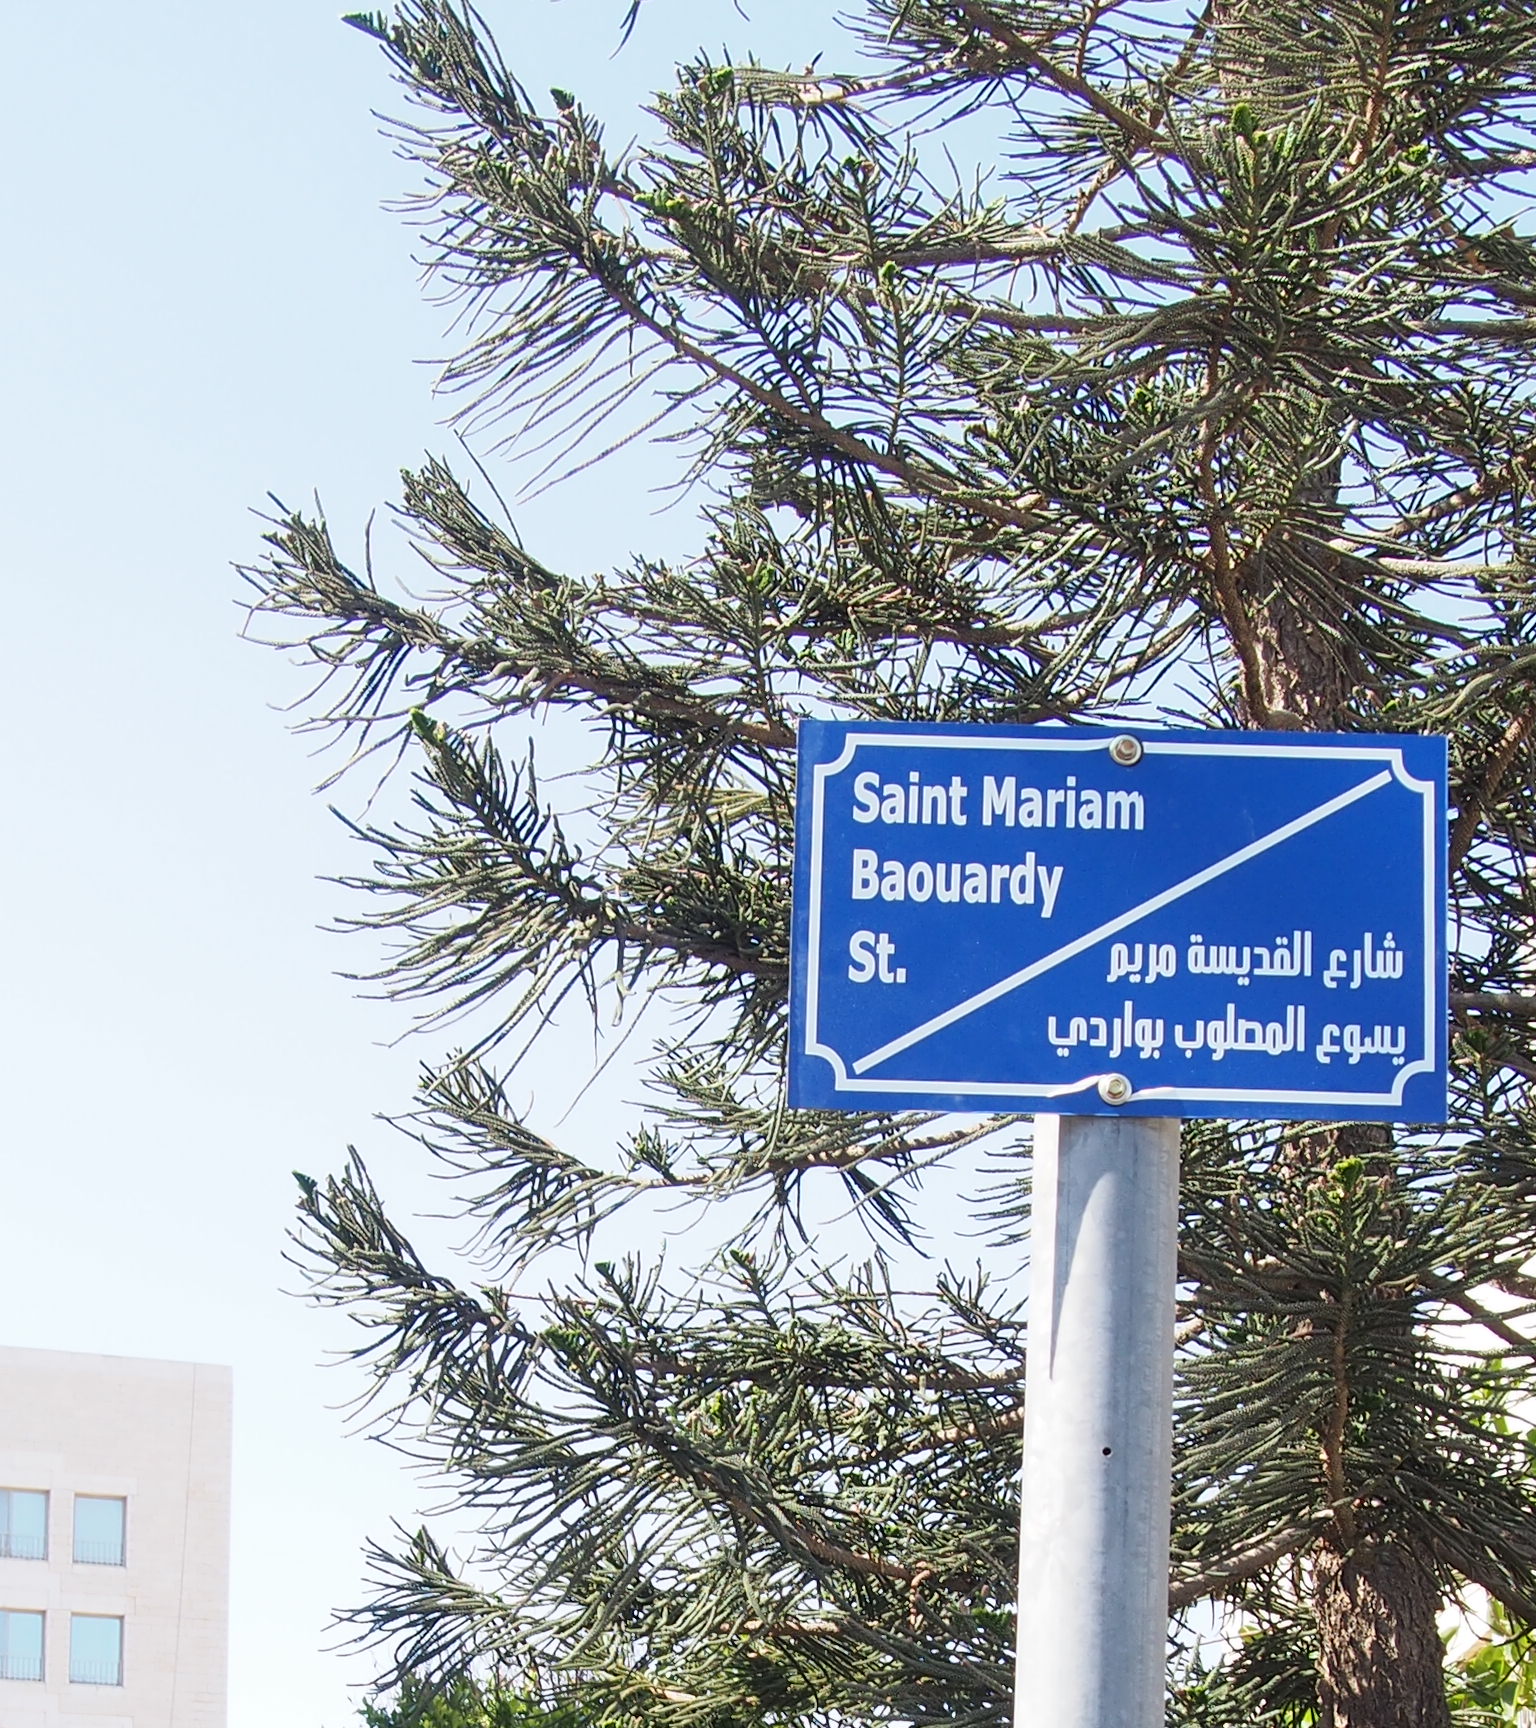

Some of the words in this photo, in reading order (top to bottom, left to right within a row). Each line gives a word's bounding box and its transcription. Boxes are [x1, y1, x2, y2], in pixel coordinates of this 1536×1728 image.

[852, 771, 968, 826] Saint
[982, 775, 1145, 830] Mariam
[851, 848, 1064, 918] Baouardy
[848, 930, 907, 983] St.
[1106, 942, 1177, 984] مريم
[1187, 930, 1312, 986] القديسة
[1322, 931, 1404, 989] شارع
[1047, 1000, 1164, 1060] بواردي
[1174, 1002, 1305, 1061] المصلوب
[1315, 1022, 1406, 1065] يسوع
